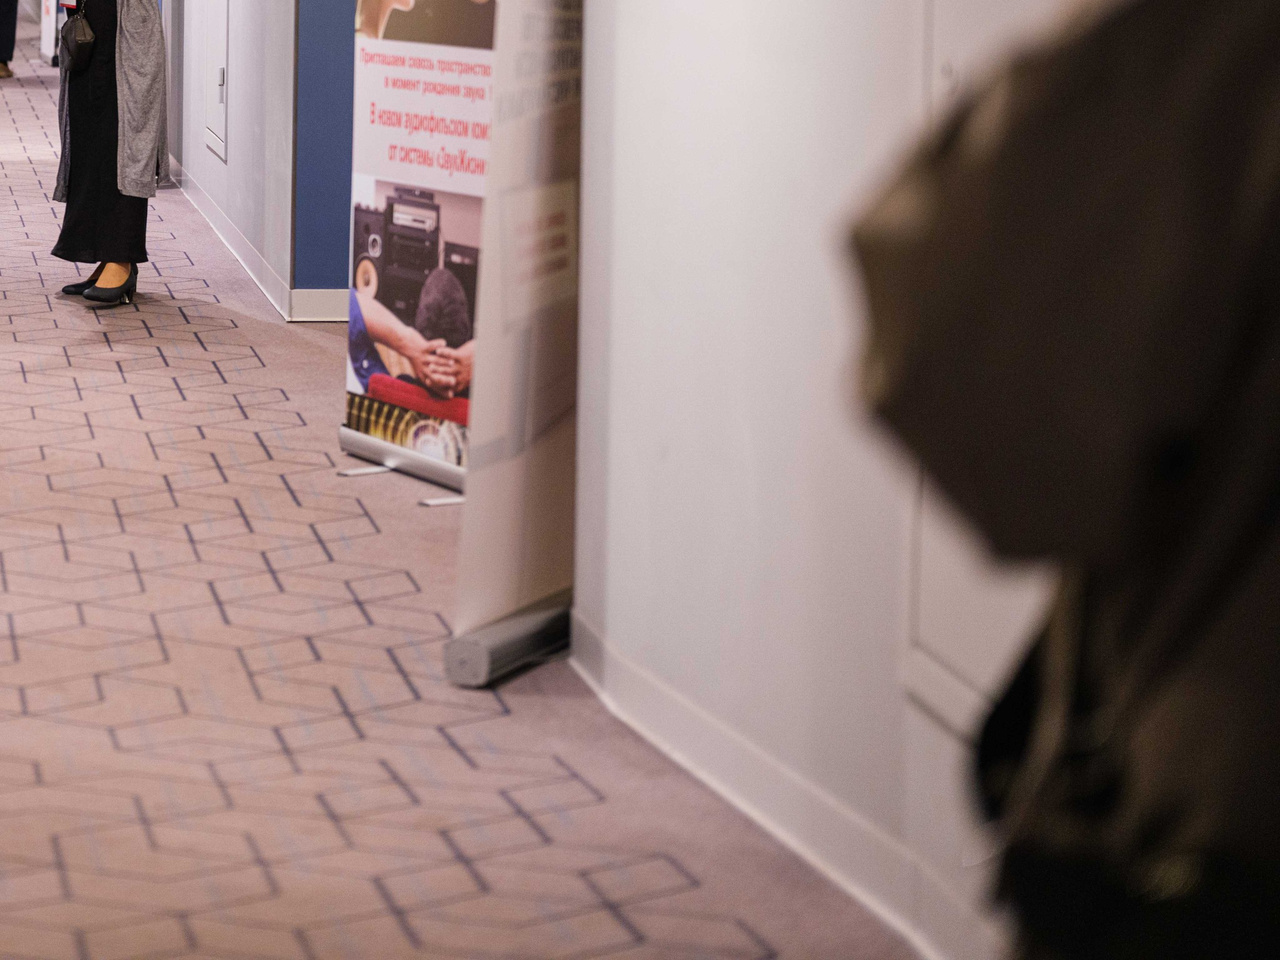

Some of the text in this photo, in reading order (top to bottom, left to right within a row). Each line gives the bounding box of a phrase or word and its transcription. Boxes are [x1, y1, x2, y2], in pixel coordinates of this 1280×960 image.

[360, 48, 406, 68] Приглашаем
[408, 56, 434, 70] сквозь
[390, 77, 421, 93] момент
[422, 80, 461, 98] рождения
[463, 87, 485, 102] звука
[370, 101, 376, 125] В
[378, 109, 401, 126] новом
[388, 144, 398, 162] от
[400, 148, 434, 166] системы
